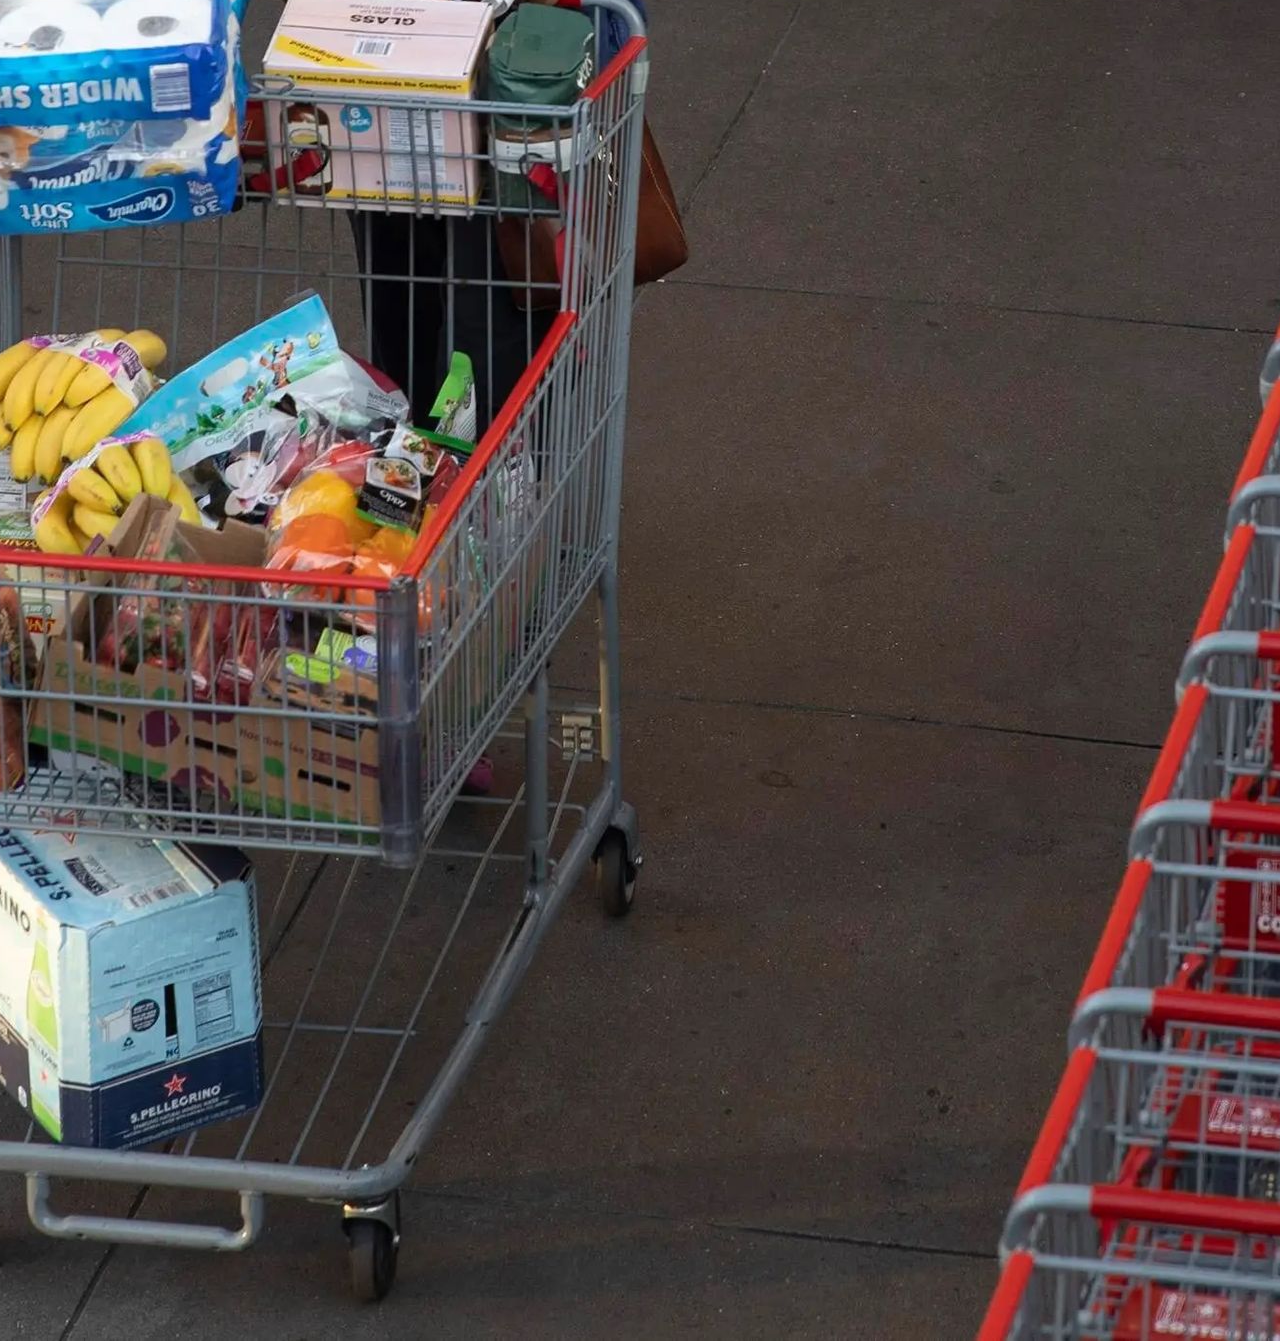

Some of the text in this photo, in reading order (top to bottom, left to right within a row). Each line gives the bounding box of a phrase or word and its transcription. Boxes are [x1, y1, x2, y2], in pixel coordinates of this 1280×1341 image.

[350, 14, 417, 26] GLASS
[299, 50, 321, 64] Keep
[296, 74, 338, 84] Kombucha
[358, 78, 402, 88] Transcends
[40, 77, 144, 107] WIDER
[350, 108, 360, 118] 6
[28, 152, 128, 190] Charmin
[20, 202, 74, 218] Soft
[108, 191, 168, 220] Charmin
[30, 216, 70, 229] Ultra
[130, 1085, 221, 1124] S.PELLEGRINO
